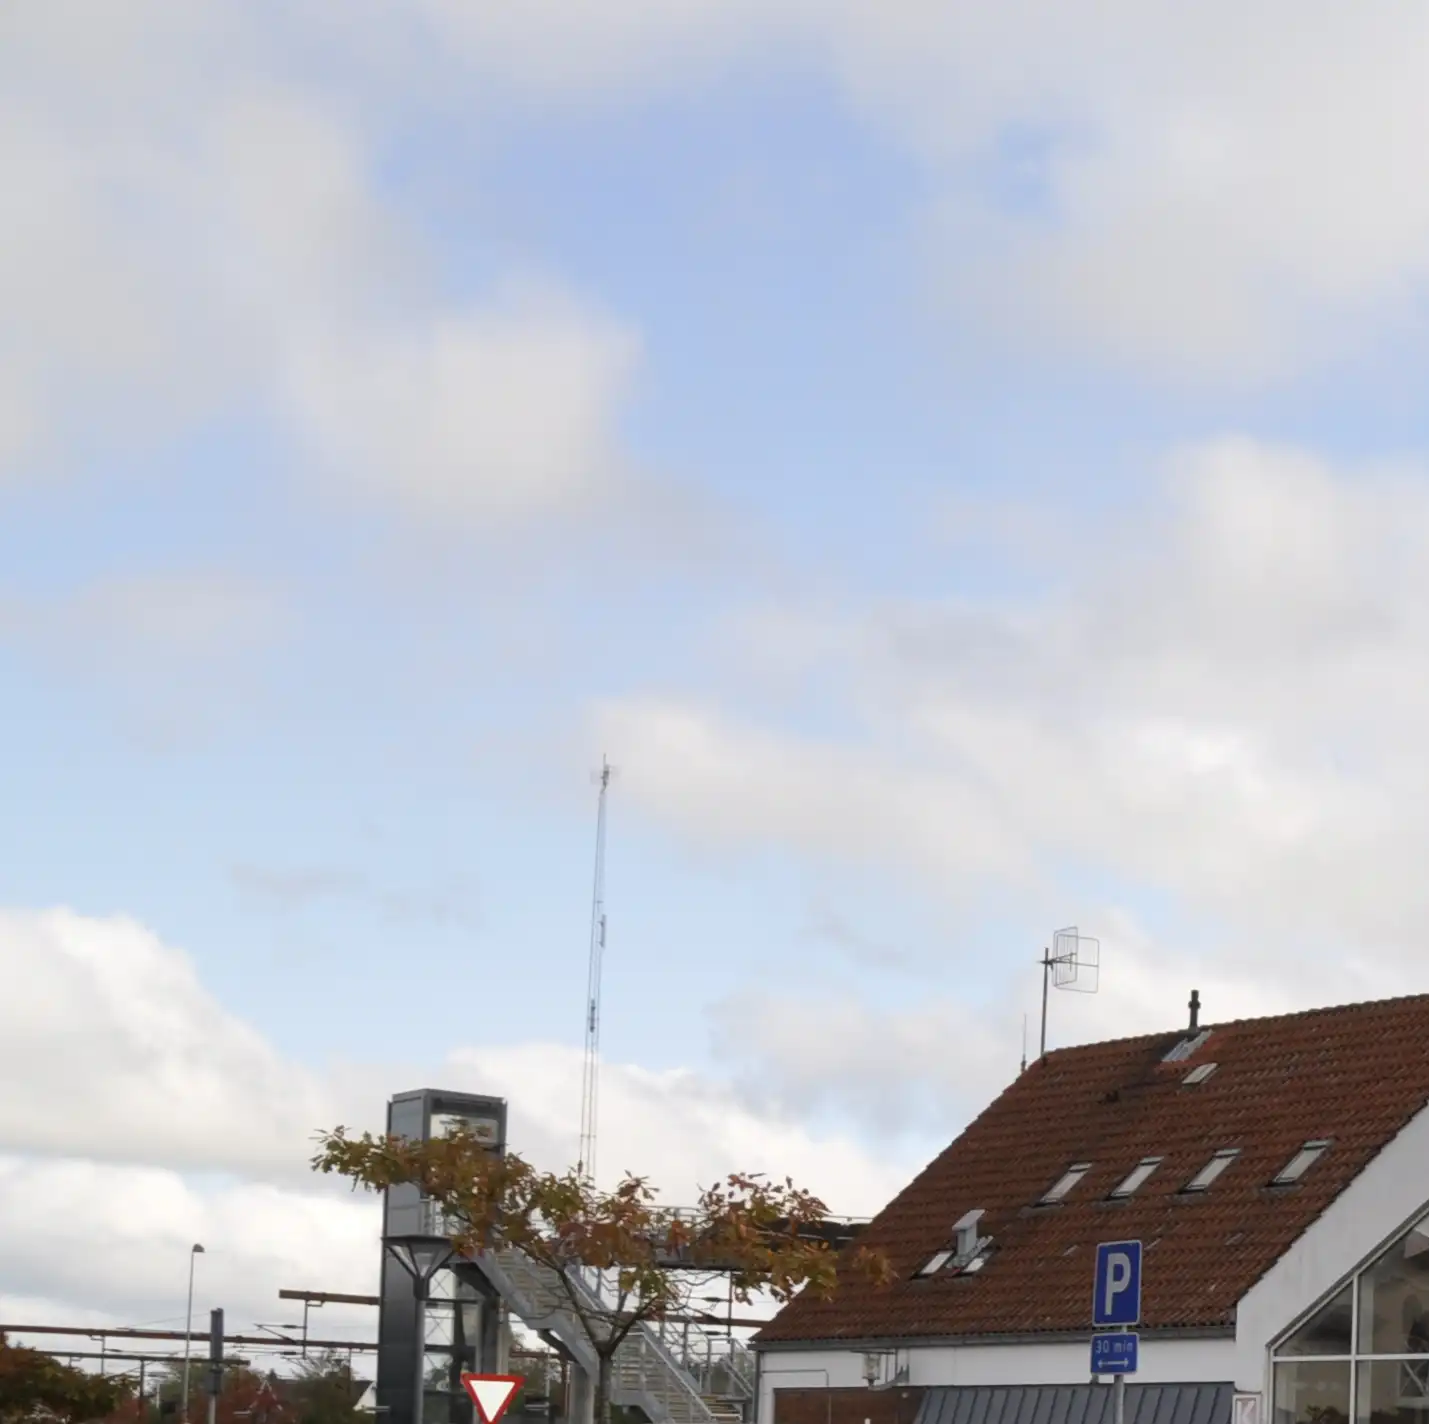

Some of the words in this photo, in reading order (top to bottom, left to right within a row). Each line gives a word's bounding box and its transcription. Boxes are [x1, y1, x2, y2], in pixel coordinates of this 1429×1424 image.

[1104, 1252, 1131, 1315] P
[1096, 1341, 1109, 1353] 30
[1113, 1340, 1133, 1353] min
